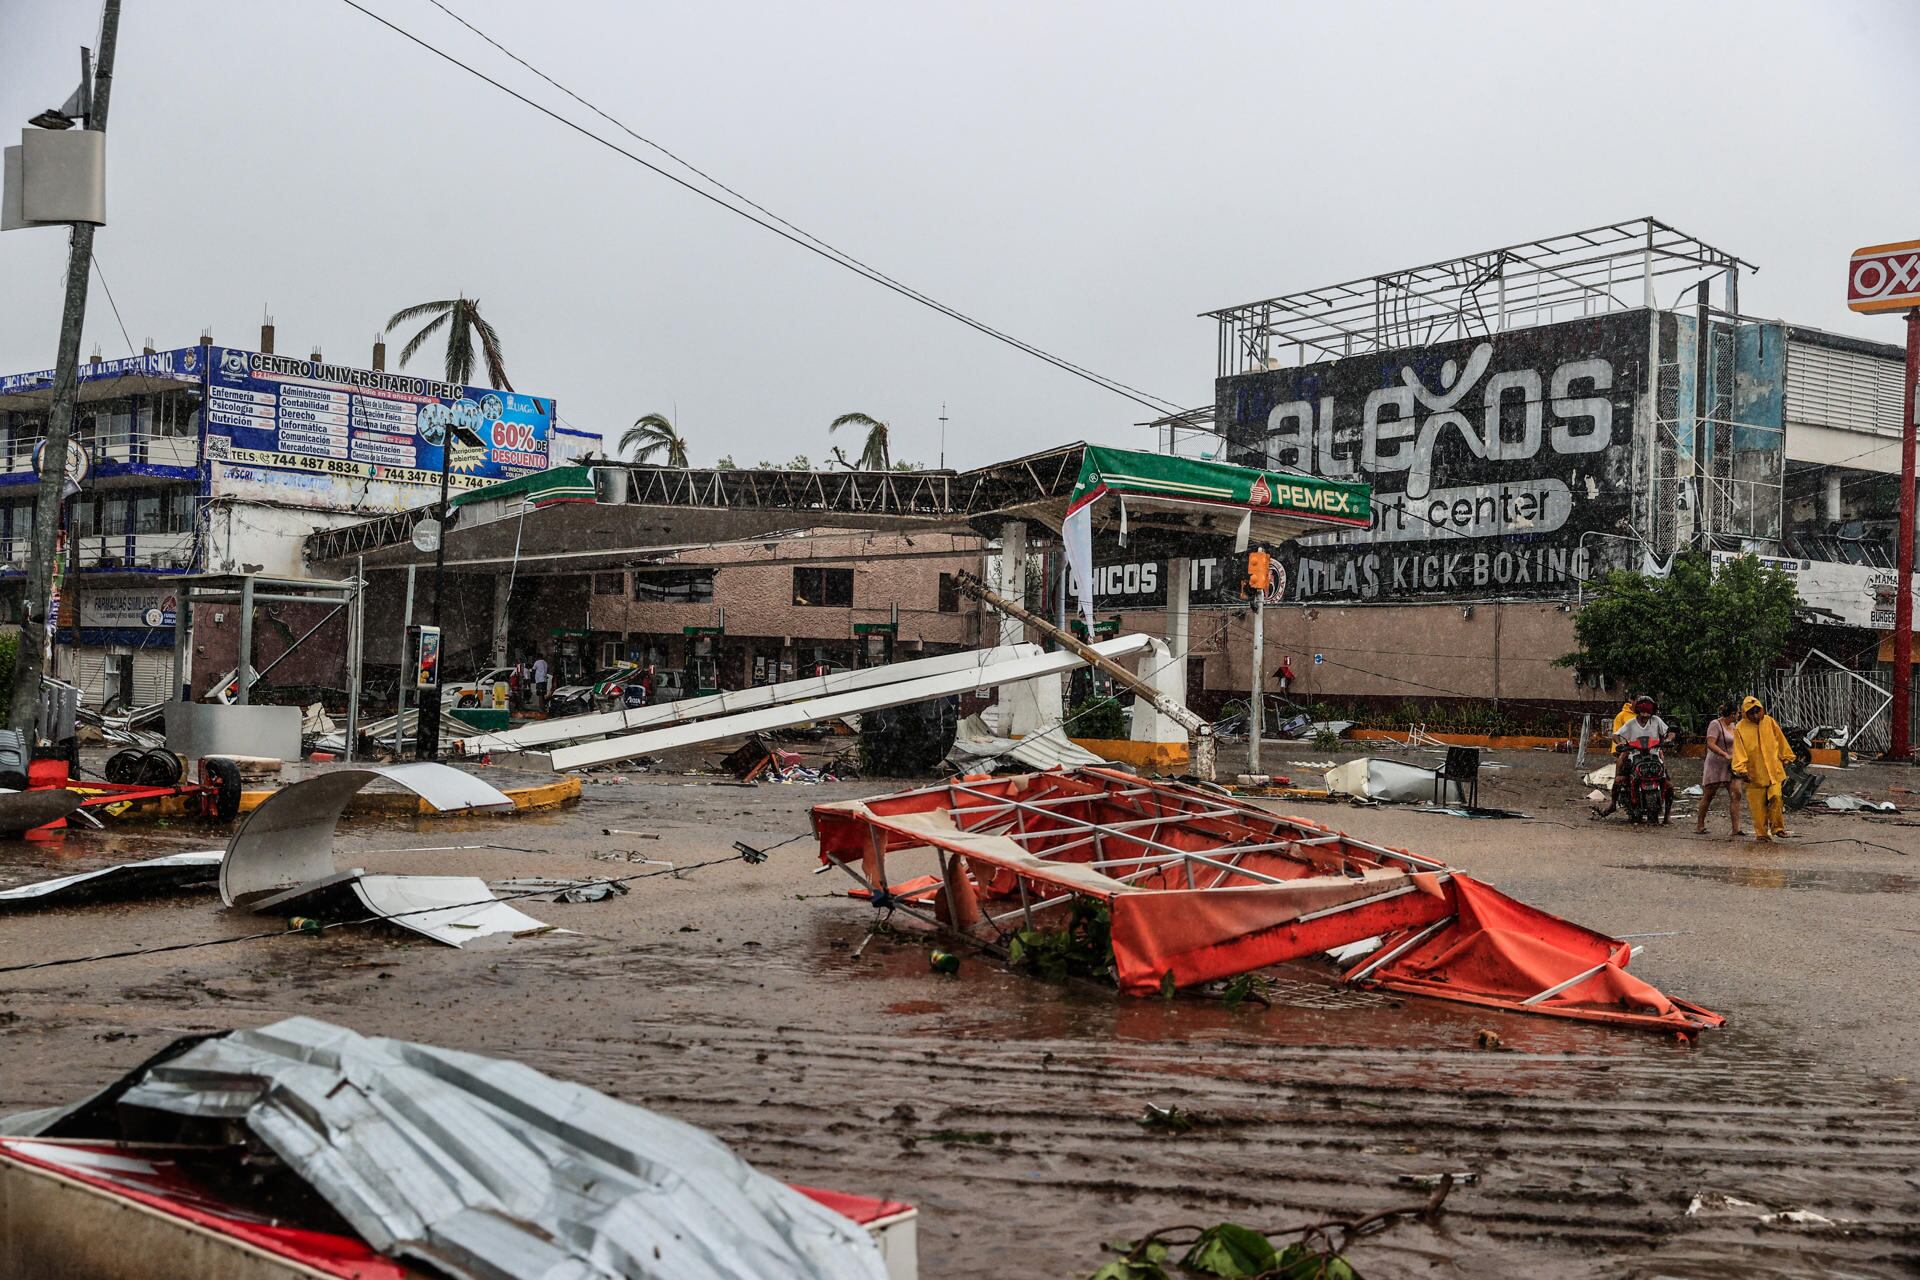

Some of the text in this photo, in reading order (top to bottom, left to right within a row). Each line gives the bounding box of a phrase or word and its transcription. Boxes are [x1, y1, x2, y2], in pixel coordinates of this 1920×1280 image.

[250, 354, 311, 378] CENTRO
[314, 363, 424, 395] UNIVERSITARIO
[427, 380, 464, 401] IPEIC
[212, 387, 254, 402] Enfermería
[282, 386, 331, 400] Administración
[212, 400, 254, 415] Psicología
[281, 397, 329, 411] Contabilidad
[212, 412, 252, 426] Nutrición
[281, 408, 316, 420] Derecho
[354, 407, 384, 419] Educación
[281, 419, 328, 433] Informática
[354, 418, 378, 429] Idioma
[280, 430, 331, 444] Comunicación
[491, 421, 536, 451] 60%
[536, 440, 547, 452] DE
[280, 441, 331, 455] Mercadotecnia
[354, 441, 400, 453] Administración
[232, 450, 258, 462] TELS.
[492, 449, 547, 468] DESCUENTO
[272, 454, 360, 474] 744 487 8834
[384, 468, 404, 479] 744
[407, 470, 428, 482] 347
[430, 473, 456, 485] 670
[464, 477, 483, 488] 744
[1277, 484, 1349, 513] PEMEX
[1362, 486, 1550, 532] ort center
[1189, 557, 1217, 591] IT
[1296, 553, 1380, 598] ATILA'S
[1871, 610, 1896, 623] BURGER
